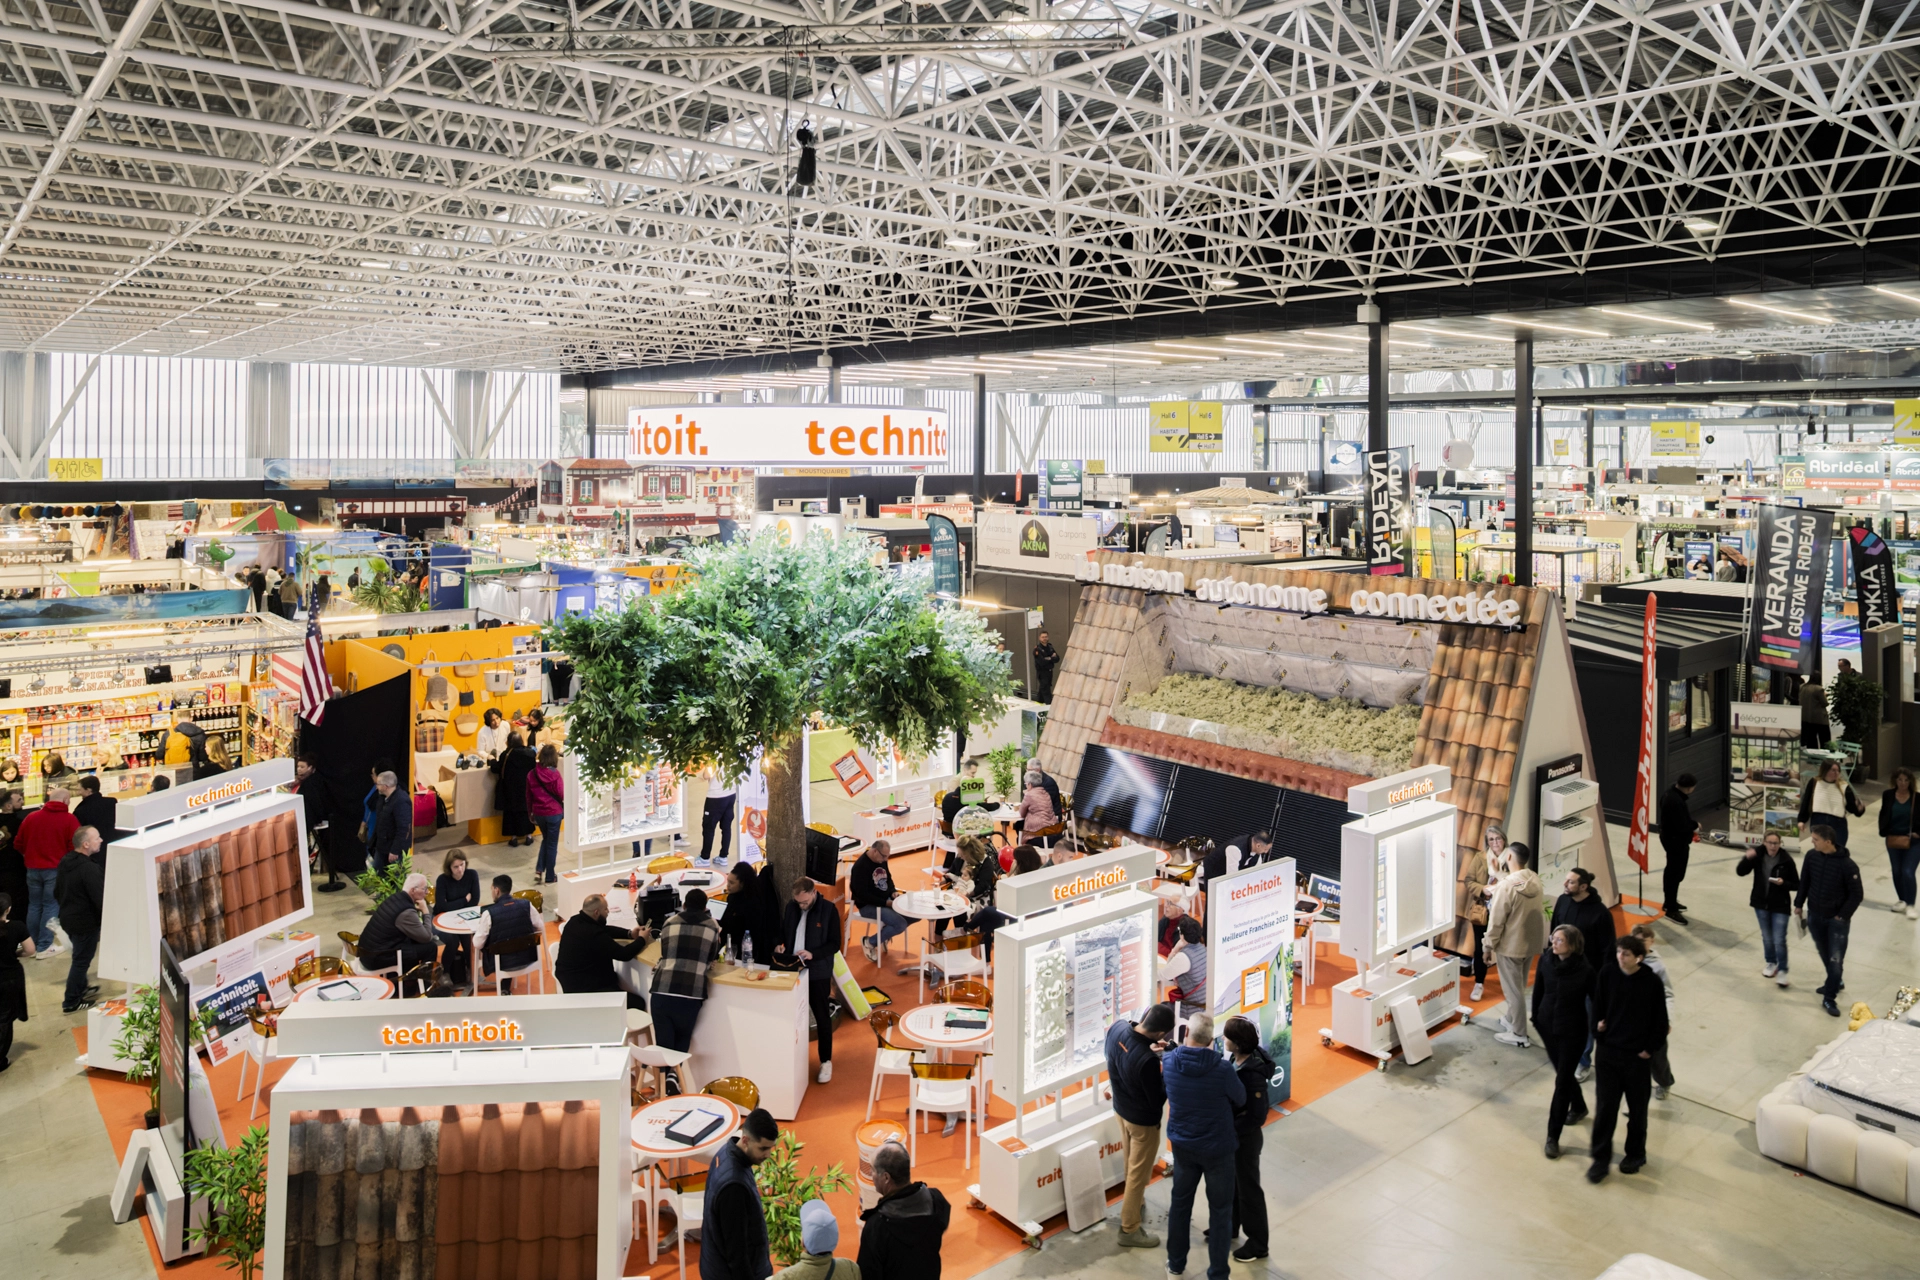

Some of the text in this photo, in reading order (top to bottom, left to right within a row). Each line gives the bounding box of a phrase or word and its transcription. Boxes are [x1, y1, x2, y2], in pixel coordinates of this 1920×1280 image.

[1021, 540, 1048, 552] AKENA
[1058, 530, 1086, 540] Carports
[28, 553, 66, 563] PRINT
[986, 545, 1087, 562] Pergolas Poolhoe
[1762, 514, 1797, 631] VERANDA
[1103, 561, 1184, 594] maison
[1195, 576, 1328, 613] autonome
[1350, 590, 1521, 626] connectée
[1788, 574, 1810, 637] GUSTAVE
[1740, 714, 1778, 724] éléganz
[1631, 616, 1655, 856] technitoit.
[1548, 762, 1576, 779] Panasonic
[188, 778, 254, 807] technitoit.
[1388, 780, 1434, 803] technitoit.
[883, 826, 905, 838] façade
[1054, 868, 1127, 900] technitoit.
[1231, 875, 1282, 901] technitoit.
[1222, 914, 1289, 944] Meilleure Franchise 2023
[382, 1019, 522, 1045] technitoit.
